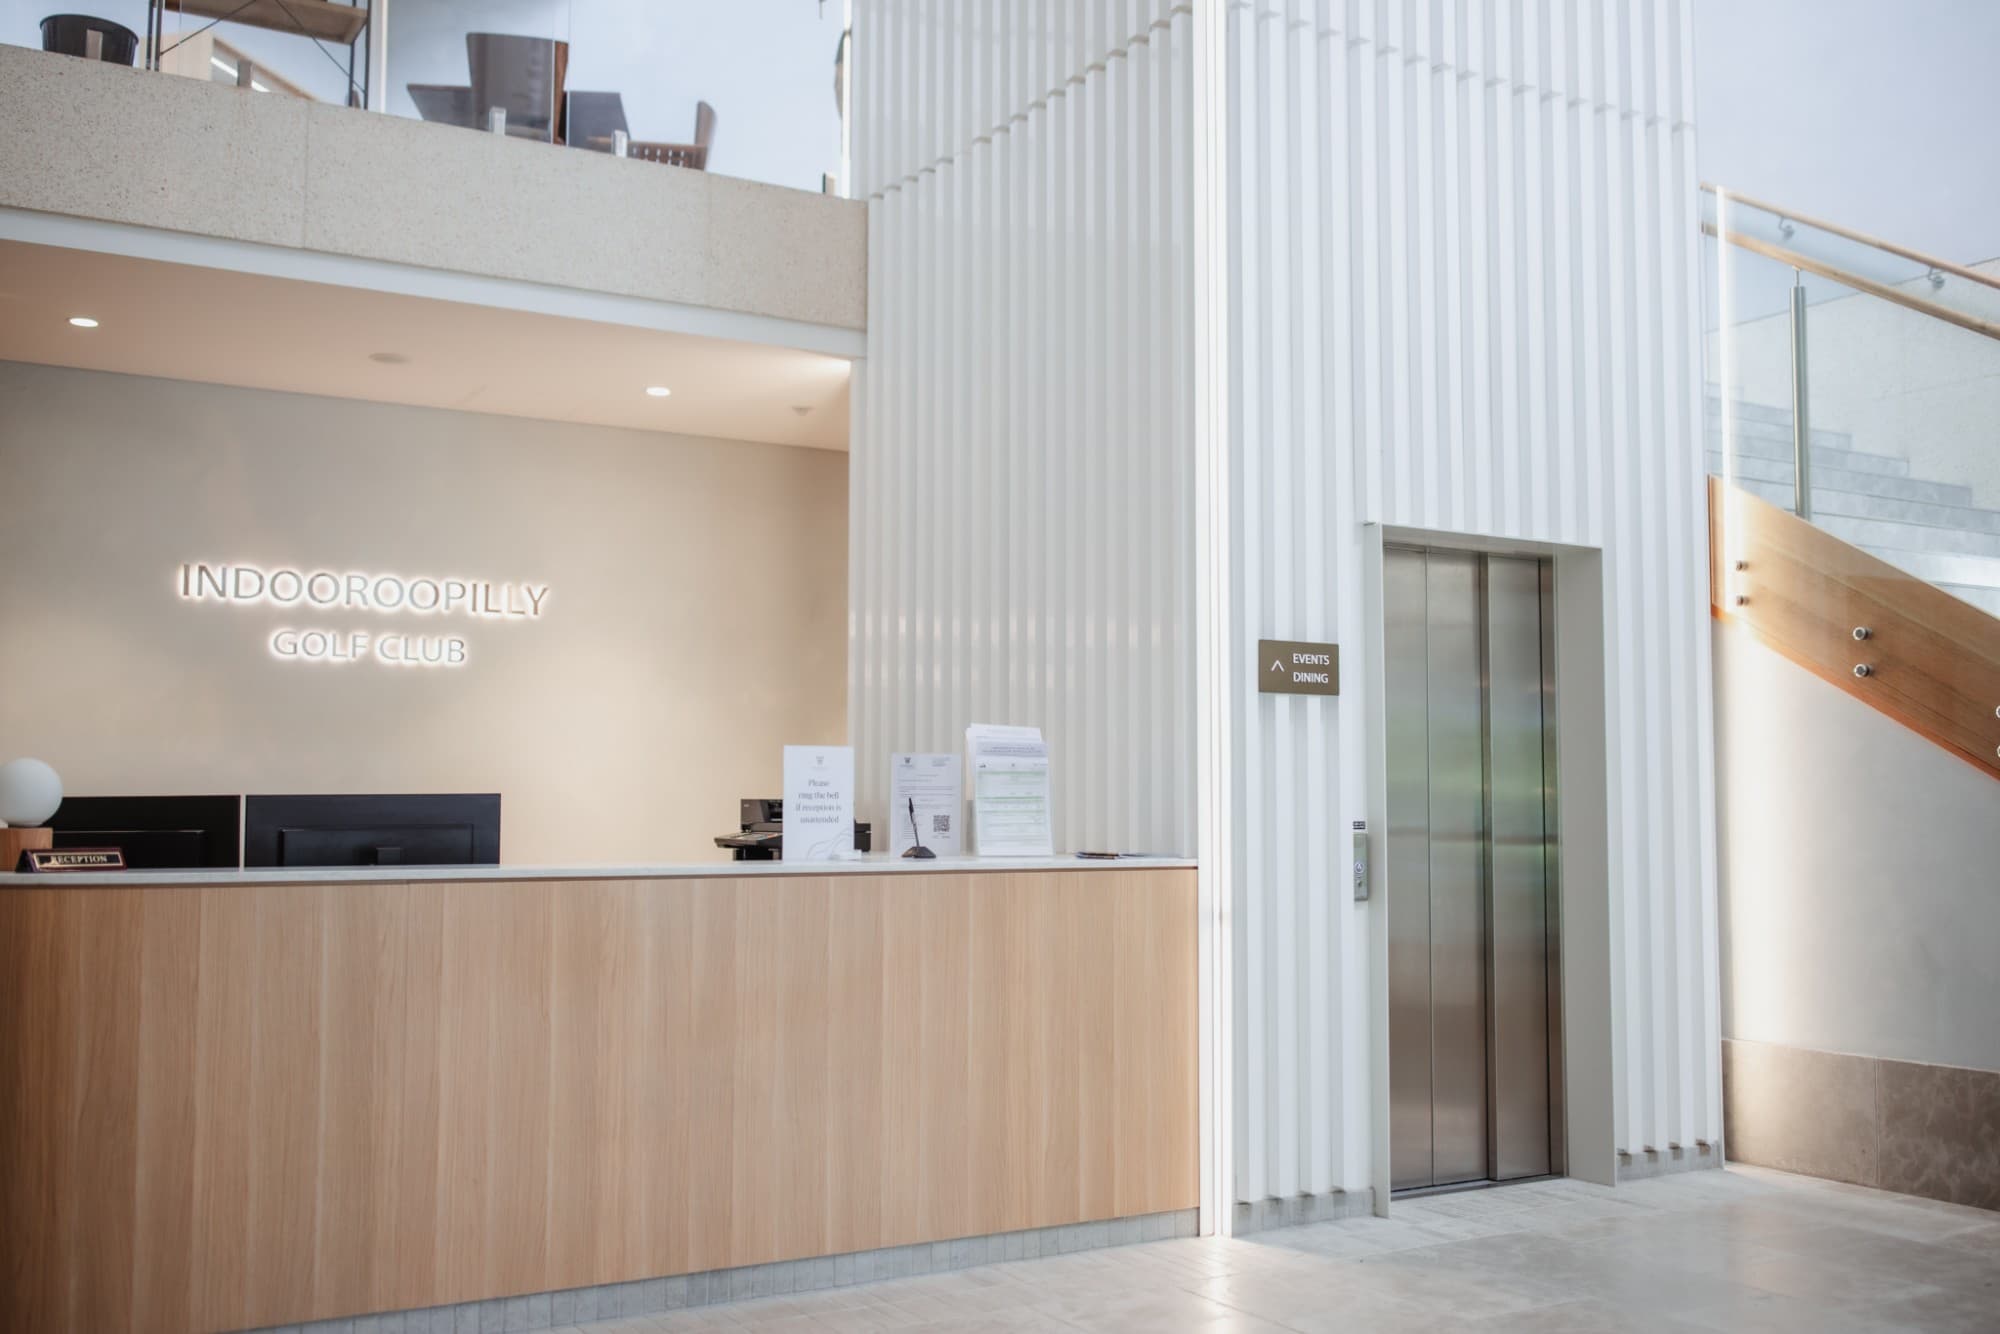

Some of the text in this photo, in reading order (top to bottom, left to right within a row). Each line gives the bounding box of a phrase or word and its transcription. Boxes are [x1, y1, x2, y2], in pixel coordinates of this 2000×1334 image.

[180, 562, 549, 617] INDOOROOPILLY
[272, 630, 466, 664] GOLF CLUB
[1292, 653, 1330, 666] EVENTS
[1293, 672, 1329, 684] DINING
[808, 779, 830, 787] Please
[798, 791, 839, 800] ring the bell
